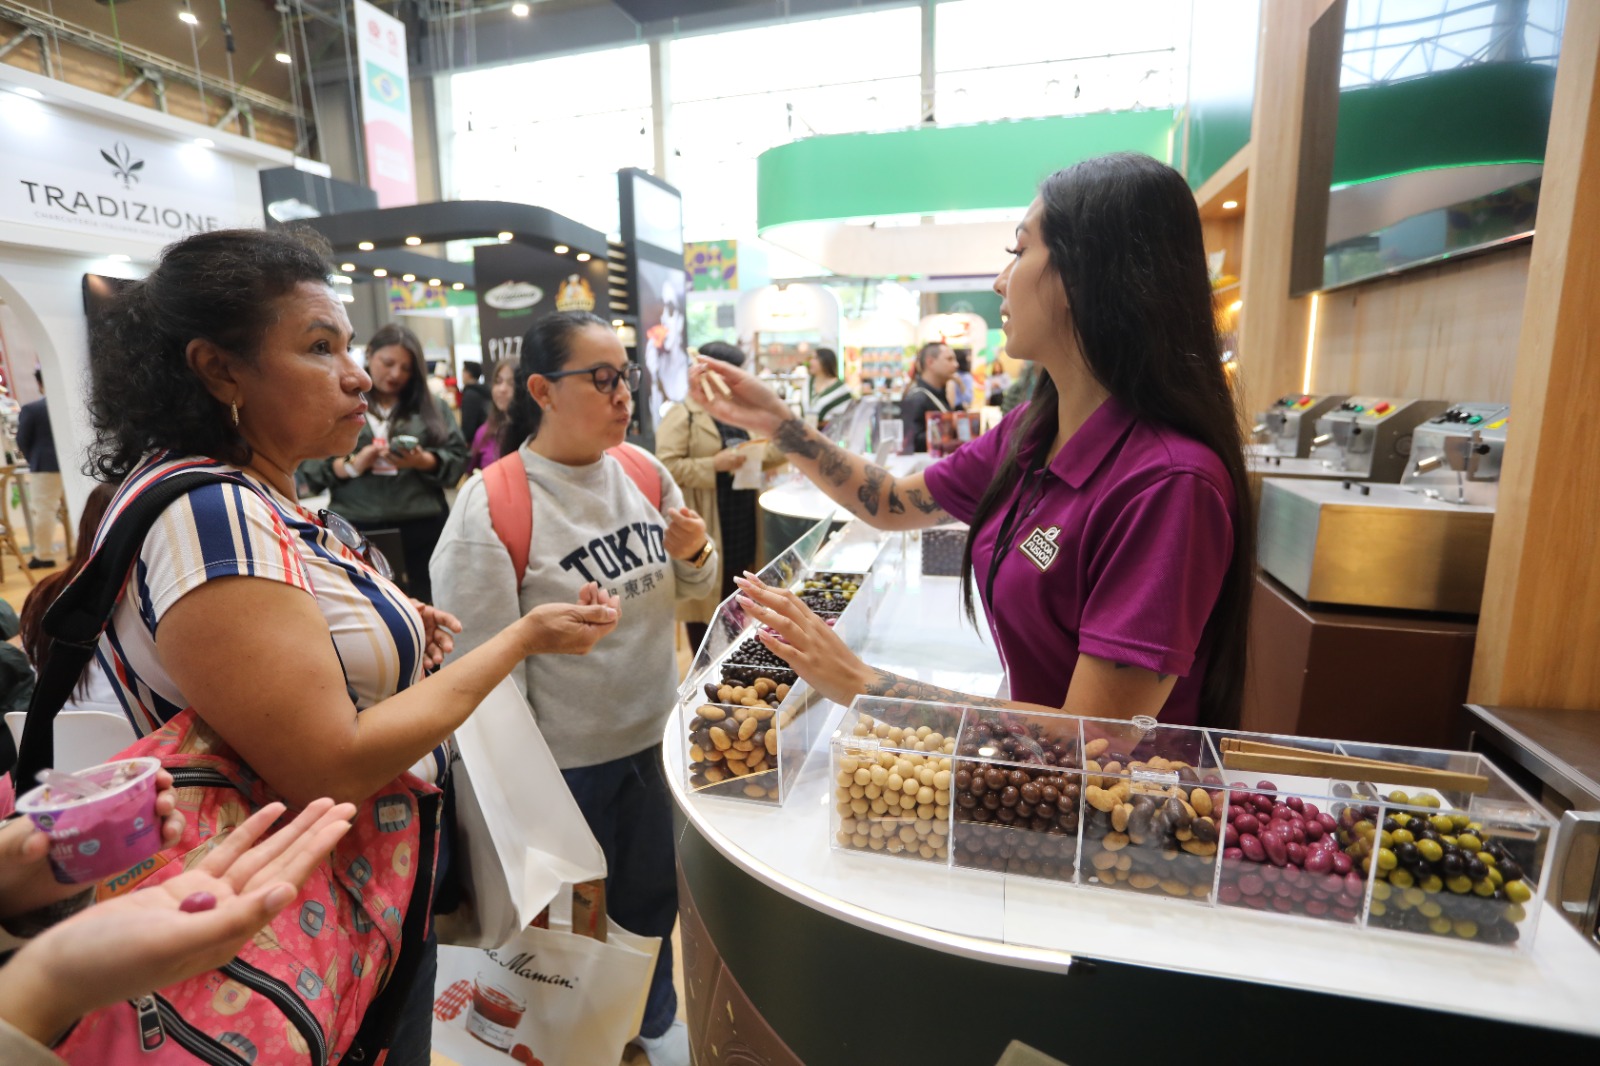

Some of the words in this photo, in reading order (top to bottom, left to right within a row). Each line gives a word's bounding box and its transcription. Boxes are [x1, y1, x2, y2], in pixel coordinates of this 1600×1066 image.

[20, 180, 219, 232] TRADIZIONE
[559, 522, 667, 588] TOKYO
[1032, 534, 1054, 557] COCOA
[623, 573, 656, 600] 東京
[107, 857, 156, 892] TOTTO
